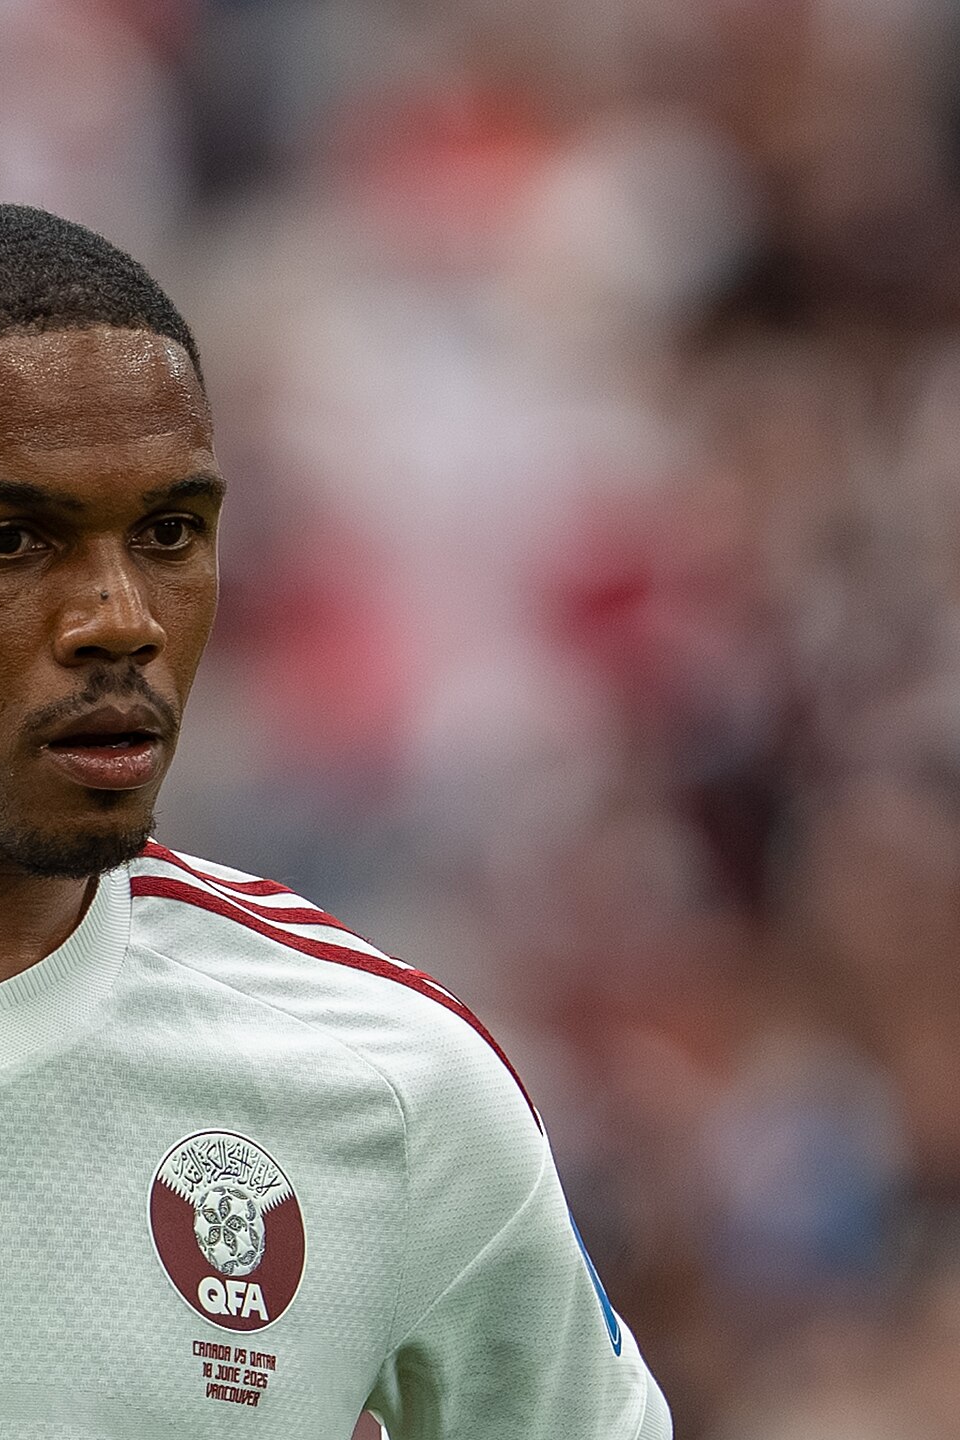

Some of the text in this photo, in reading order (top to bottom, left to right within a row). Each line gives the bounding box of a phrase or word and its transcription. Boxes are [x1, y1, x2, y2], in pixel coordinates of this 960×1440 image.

[197, 1276, 269, 1321] QFA
[192, 1340, 277, 1372] CANADA VS QATAR
[203, 1362, 269, 1390] 18 JUNE 2026
[206, 1383, 261, 1407] VANCOUVER
